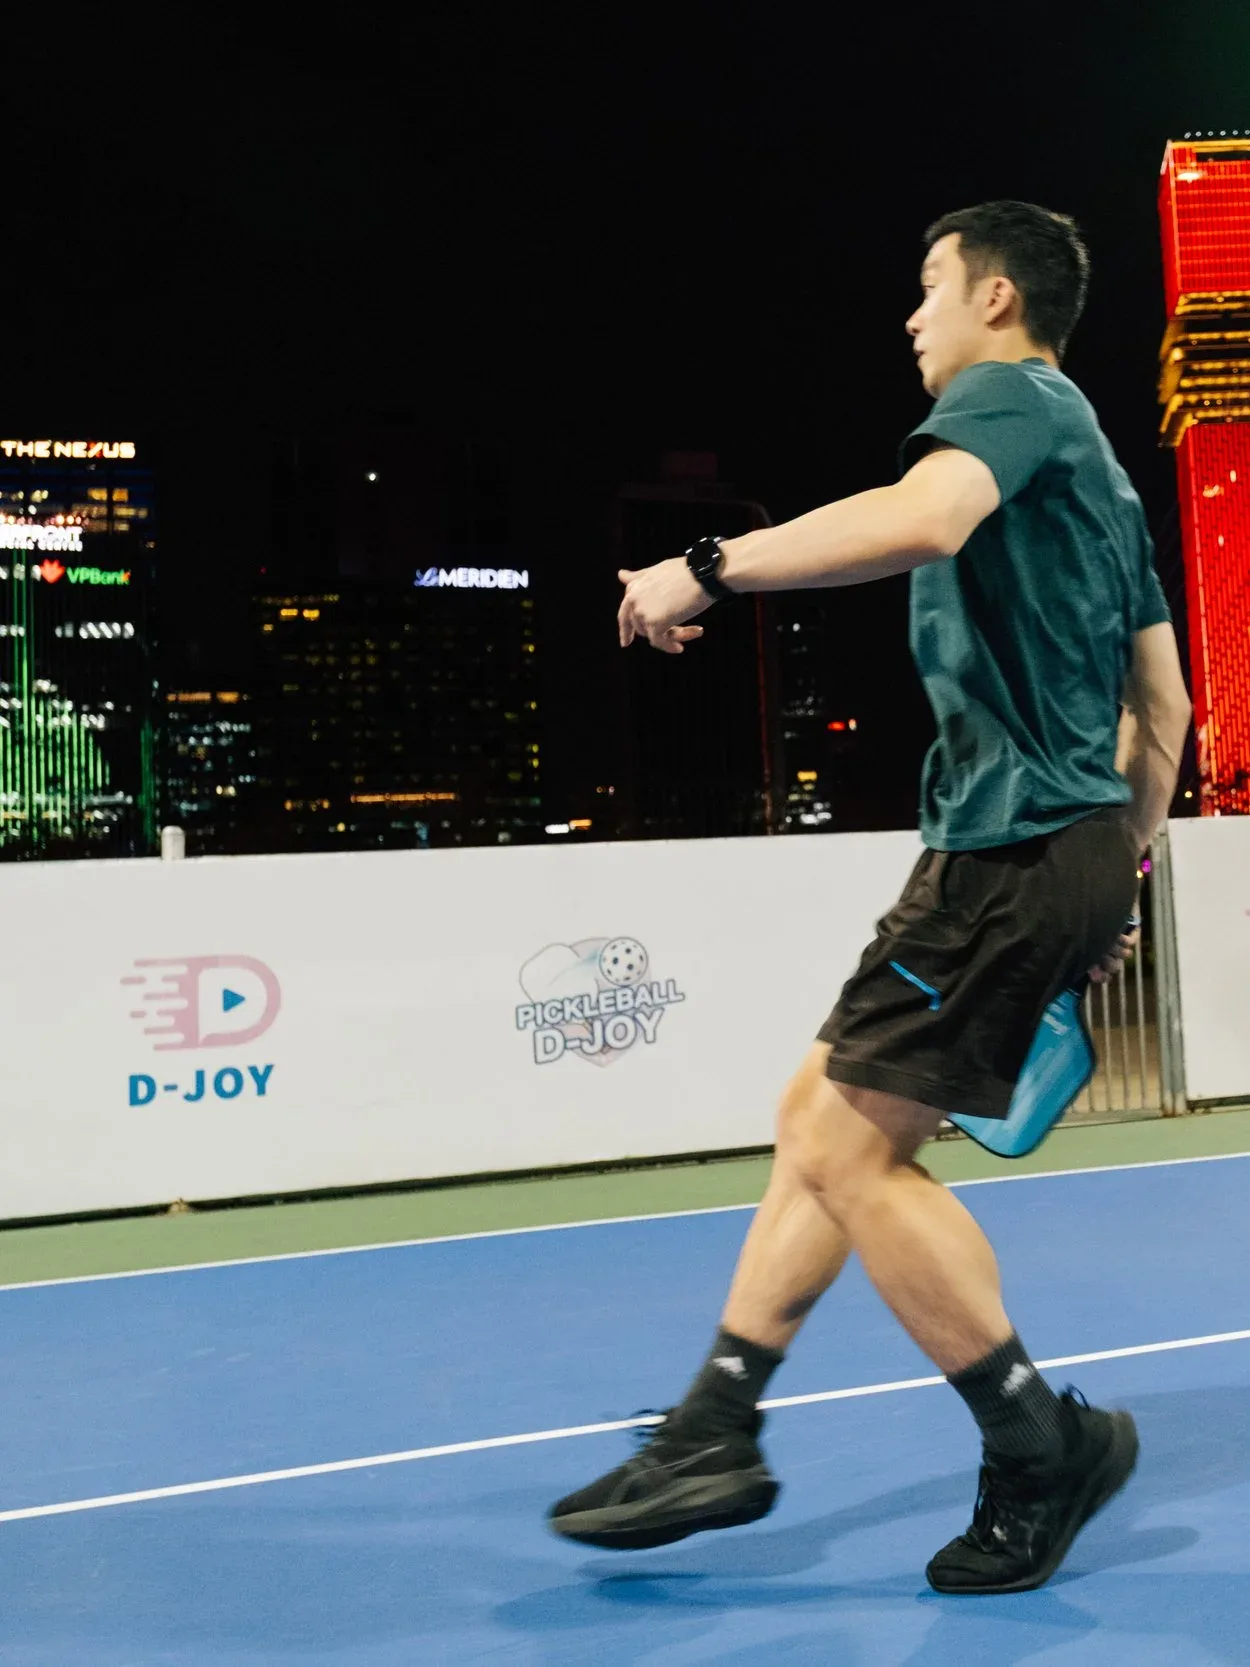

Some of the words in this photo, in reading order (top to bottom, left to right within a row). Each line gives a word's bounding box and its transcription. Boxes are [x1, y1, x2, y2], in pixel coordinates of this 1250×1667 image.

[0, 439, 51, 458] THE
[54, 441, 136, 459] NEXUS
[66, 567, 131, 586] VPBank
[439, 567, 529, 589] MERIDIEN
[515, 978, 686, 1031] PICKLEBALL
[532, 1006, 665, 1065] D-JOY
[128, 1064, 274, 1107] D-JOY
